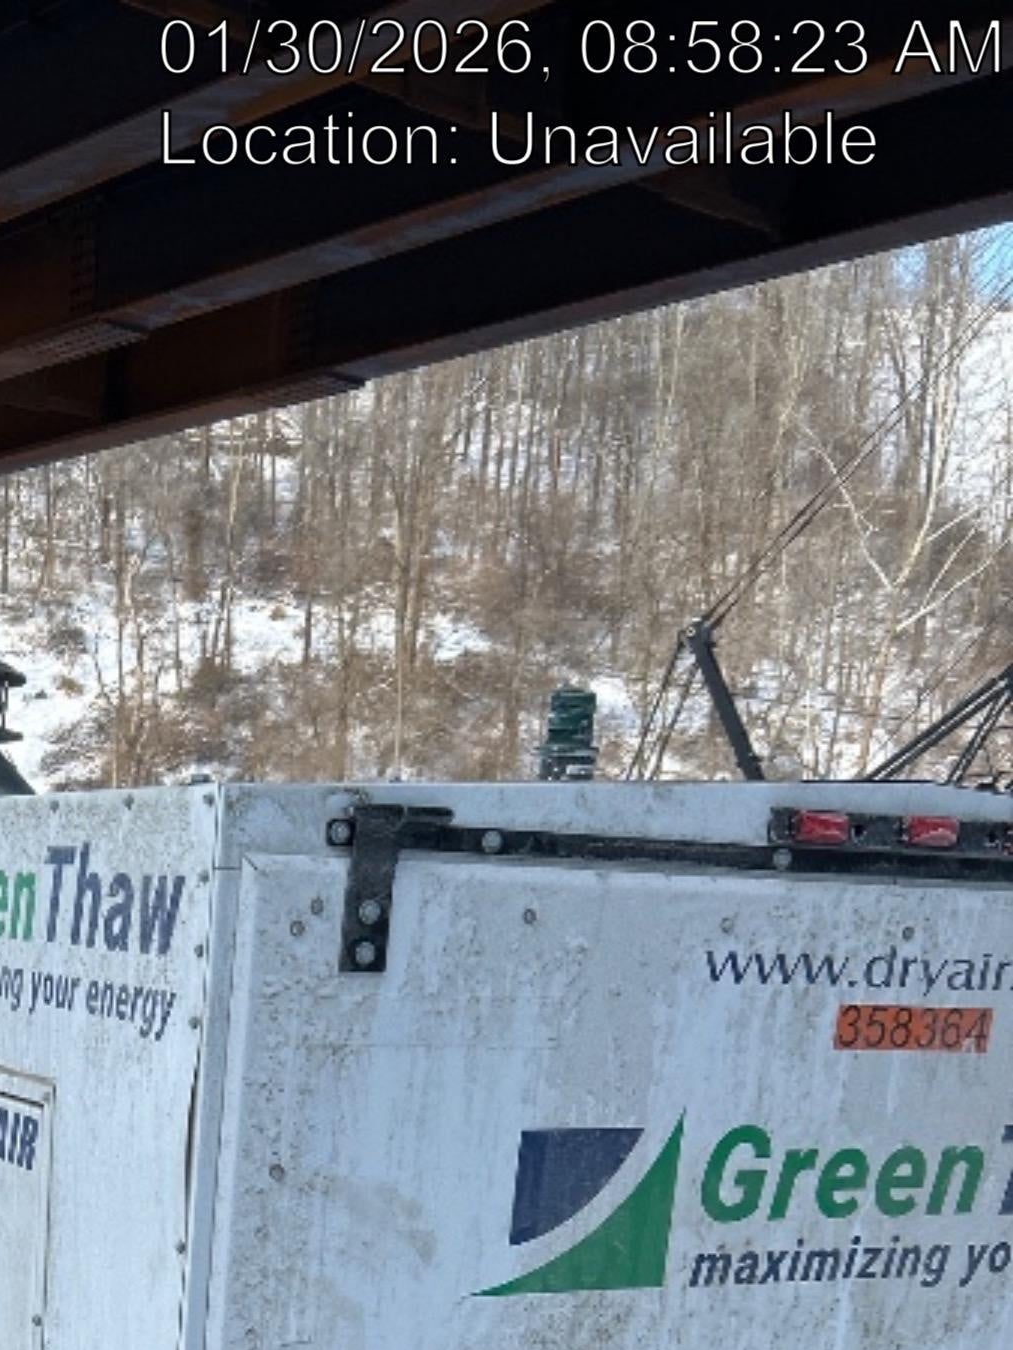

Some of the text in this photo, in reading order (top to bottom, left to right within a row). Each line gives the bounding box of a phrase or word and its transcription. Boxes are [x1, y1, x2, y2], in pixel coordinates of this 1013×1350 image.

[27, 970, 81, 1015] your
[86, 977, 178, 1042] energy
[839, 1004, 987, 1052] 358364
[688, 1235, 951, 1288] maximizing
